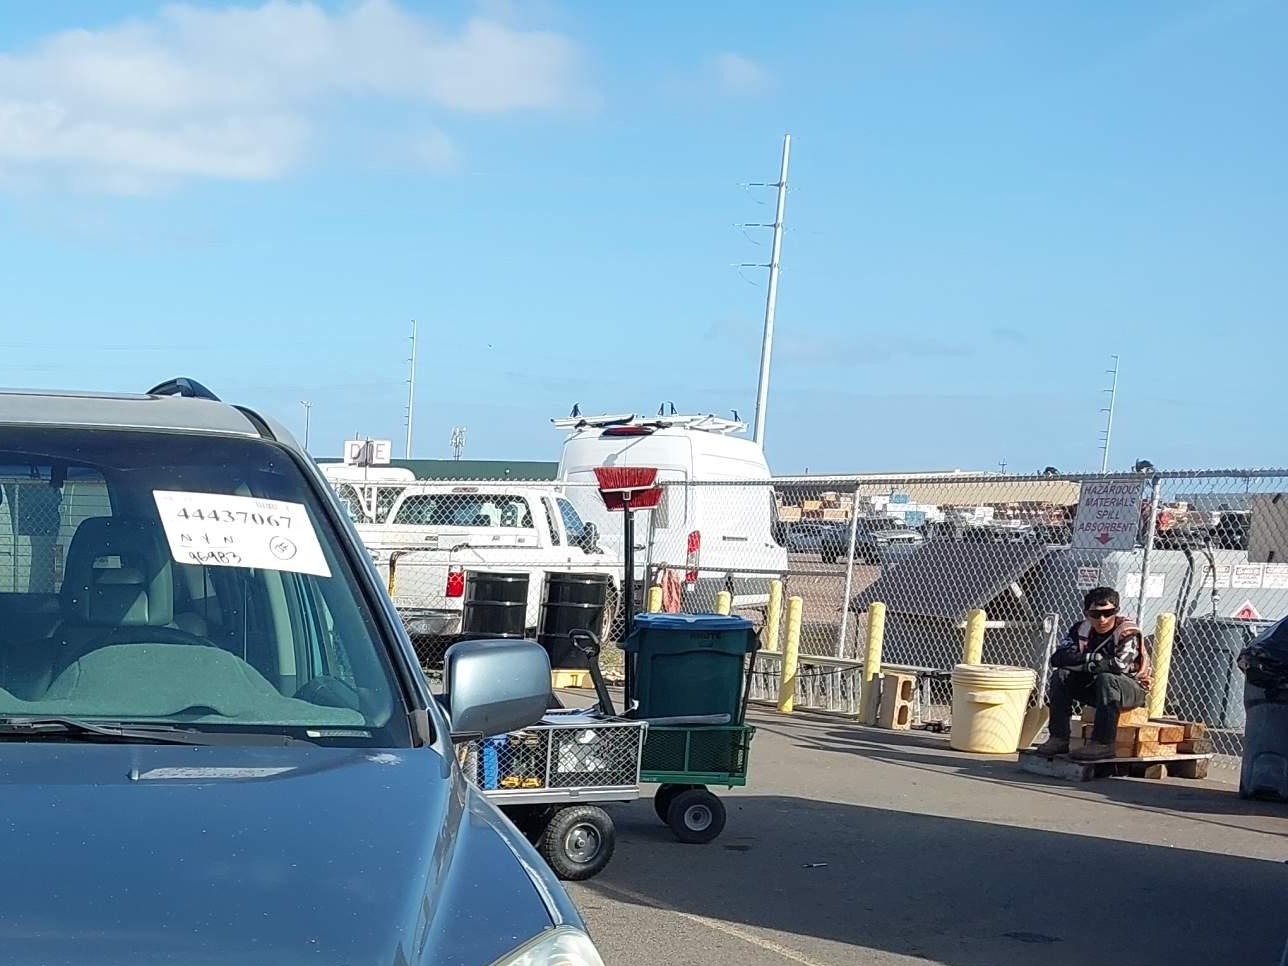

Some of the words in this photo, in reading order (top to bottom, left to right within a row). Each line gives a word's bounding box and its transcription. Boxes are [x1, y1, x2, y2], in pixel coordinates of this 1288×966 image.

[1084, 485, 1141, 494] HAZARDOUS
[1085, 498, 1136, 507] MATERIALS
[176, 507, 292, 529] 44437067
[1096, 510, 1120, 520] SPILL
[1078, 522, 1136, 532] ABSORBENT
